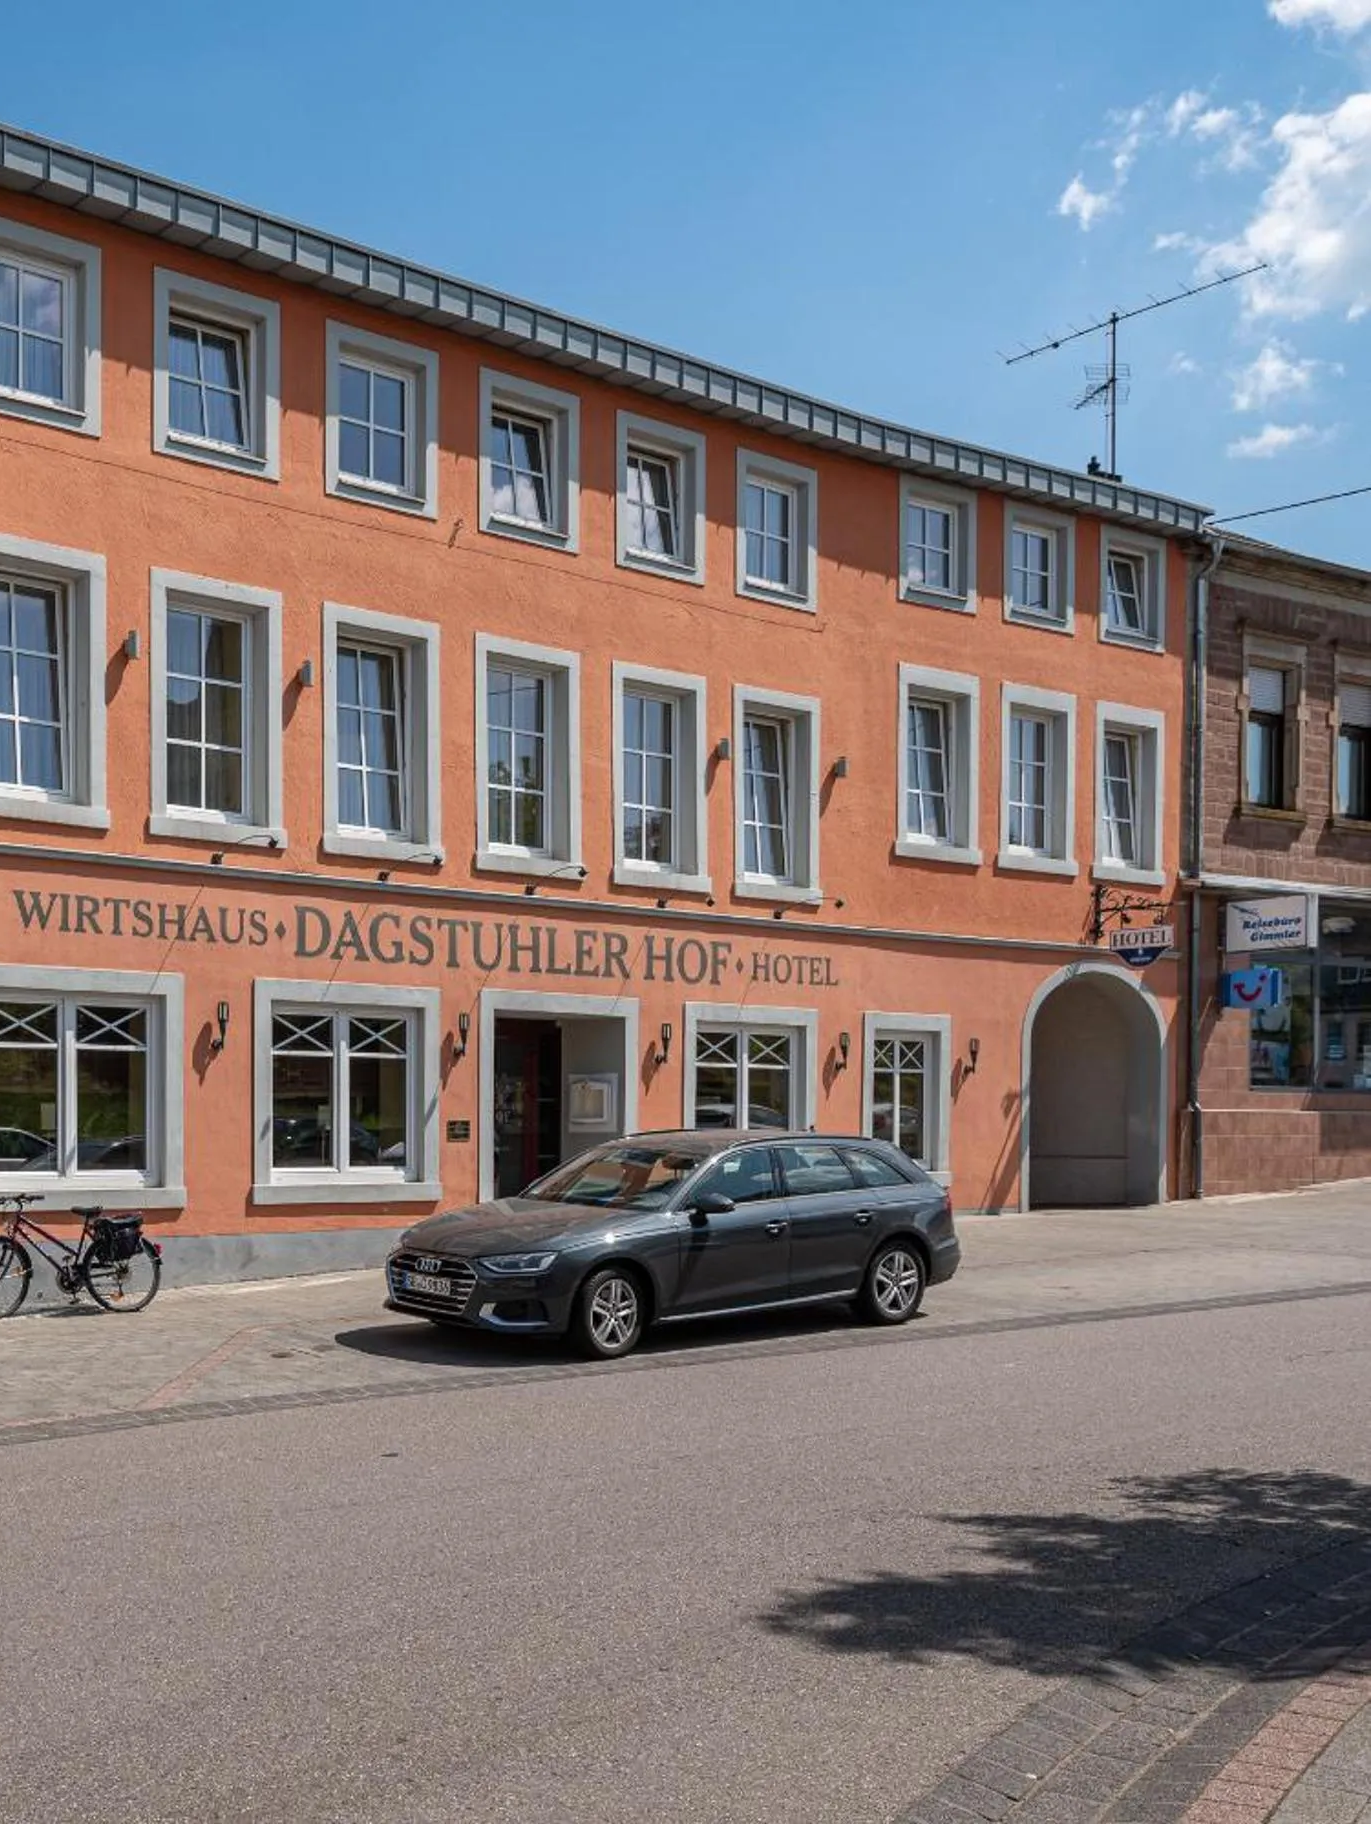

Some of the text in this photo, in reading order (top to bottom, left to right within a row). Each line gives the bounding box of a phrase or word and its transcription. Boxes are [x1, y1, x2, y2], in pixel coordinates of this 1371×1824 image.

[12, 889, 840, 987] WIRTSHAUS DAGSTUHLER HOF HOTEL
[1113, 929, 1171, 947] HOTEL
